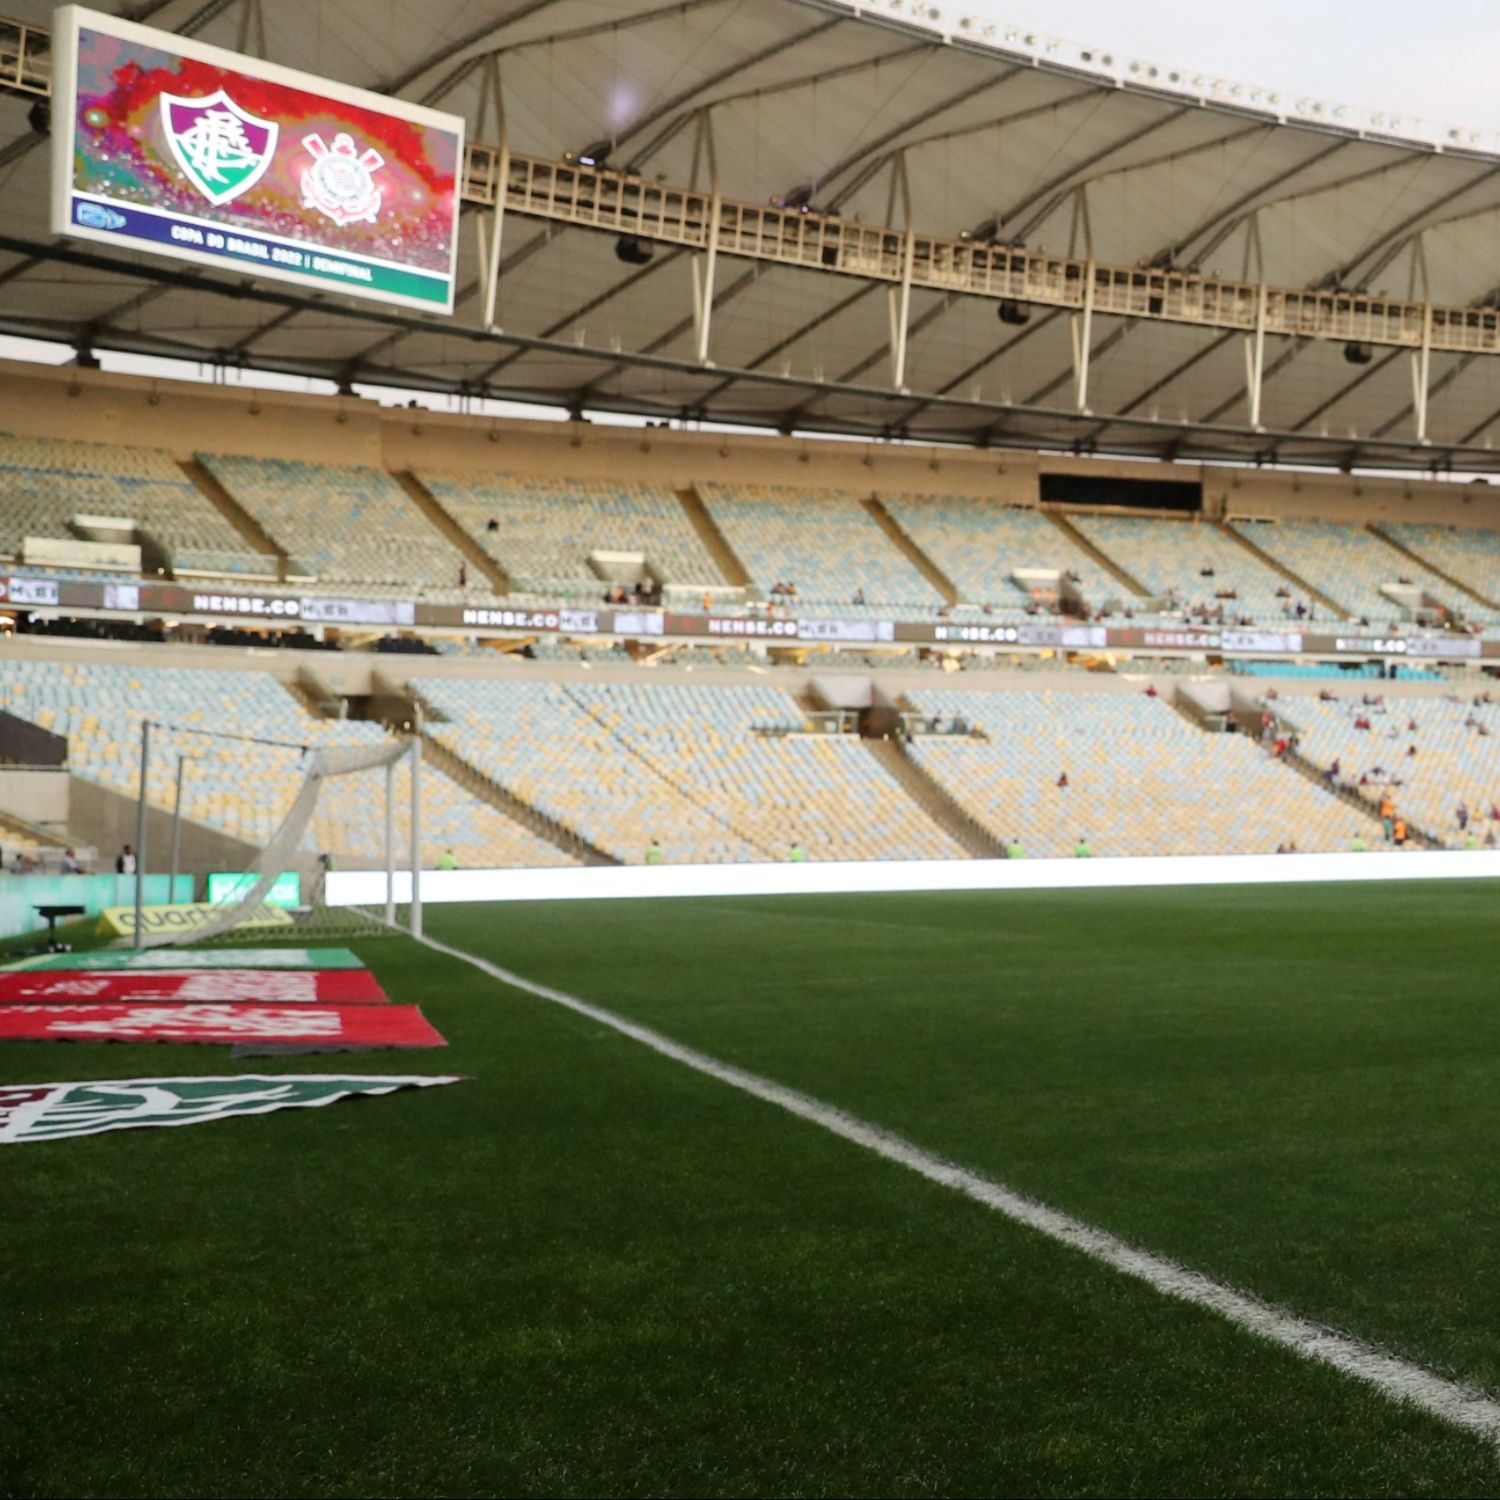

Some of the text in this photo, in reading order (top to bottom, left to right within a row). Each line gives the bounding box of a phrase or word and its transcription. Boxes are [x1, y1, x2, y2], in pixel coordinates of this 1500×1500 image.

[171, 225, 203, 245] COPA
[227, 237, 269, 259] BRASIL
[312, 256, 373, 282] SEMIFINAL
